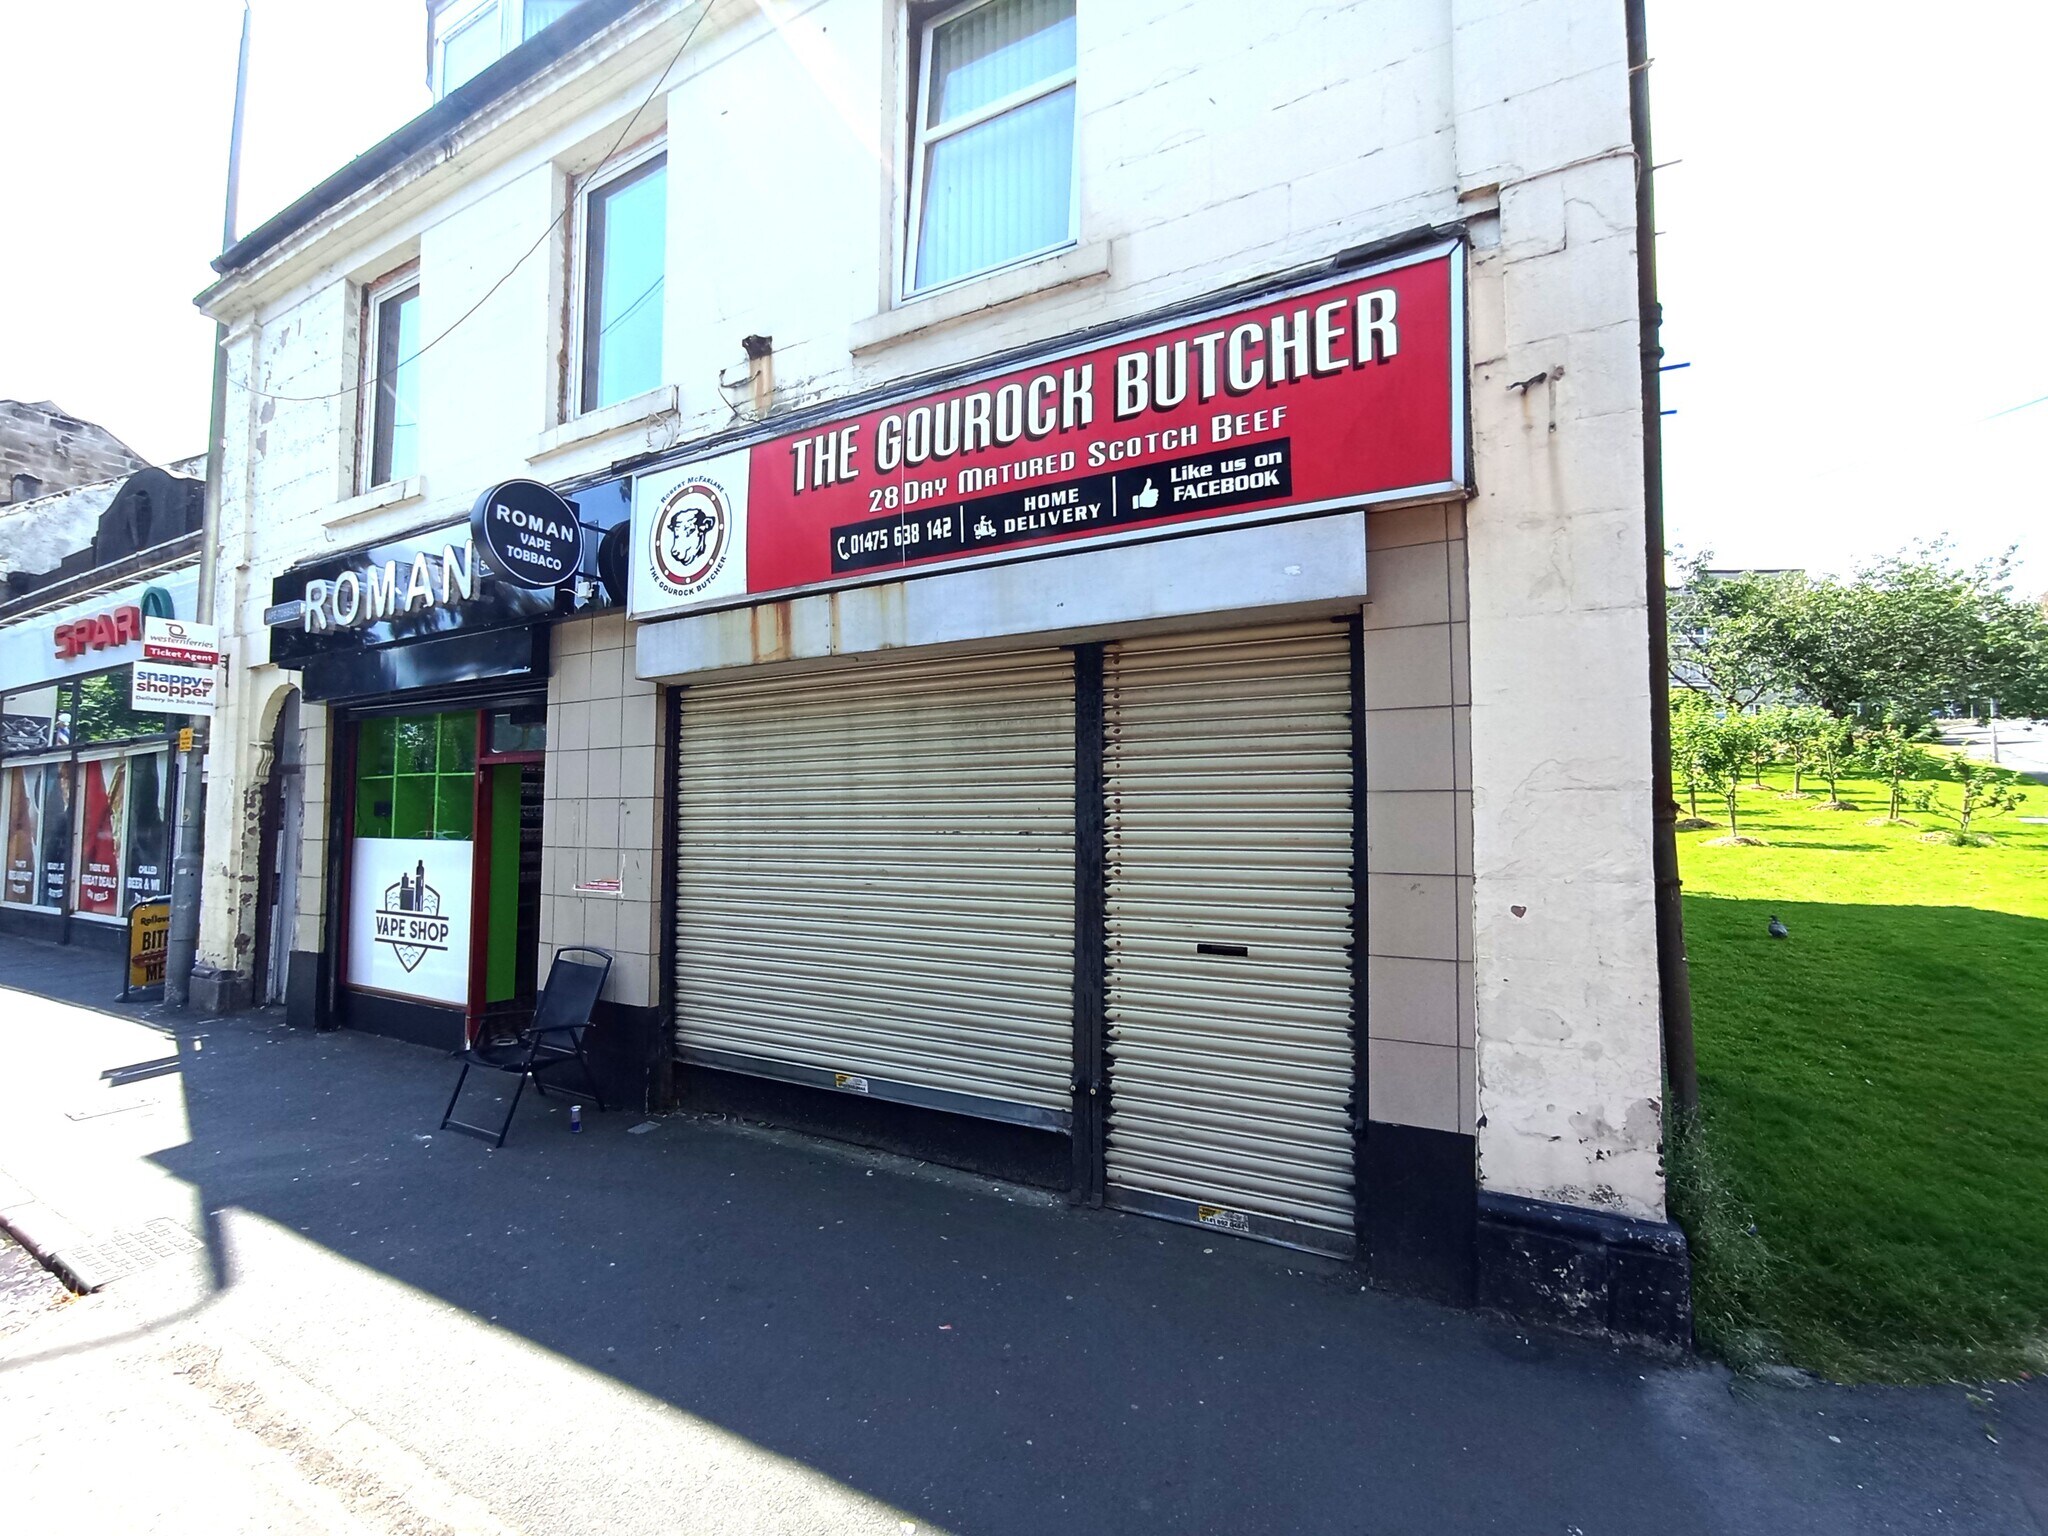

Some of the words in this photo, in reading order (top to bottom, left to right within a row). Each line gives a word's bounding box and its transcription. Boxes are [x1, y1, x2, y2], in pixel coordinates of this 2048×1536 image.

[792, 425, 860, 491] THE
[877, 363, 1094, 471] GOUROCK
[1116, 288, 1398, 417] BUTCHER
[958, 451, 1076, 494] MATURED
[1087, 425, 1198, 468] SCOTCH
[1211, 406, 1288, 443] BEEF
[1170, 464, 1213, 483] Like
[1220, 458, 1247, 473] us
[1254, 452, 1283, 467] on
[1023, 488, 1080, 512] HOME
[1173, 469, 1280, 503] FACEBOOK
[496, 503, 575, 543] ROMAN
[1004, 503, 1102, 534] DELIVERY
[520, 532, 552, 553] VAPE
[850, 529, 888, 553] 01475
[893, 524, 920, 546] 638
[926, 517, 952, 541] 142
[506, 544, 563, 572] TOBBACO
[304, 538, 475, 634] ROMAN
[649, 566, 659, 583] THE
[659, 581, 695, 597] GOUROCK
[696, 556, 728, 593] BUTCHER
[54, 606, 142, 660] SPAR
[150, 635, 214, 649] westernferries
[150, 648, 182, 658] Ticket
[183, 652, 213, 662] Agent
[136, 681, 210, 698] shopper
[137, 671, 202, 688] snappy
[135, 695, 165, 703] Delivery
[82, 874, 98, 886] GREAT
[99, 875, 116, 889] DEALS
[127, 876, 143, 889] BEER
[144, 878, 149, 890] &
[376, 916, 406, 938] VAPE
[409, 920, 449, 943] SHOP
